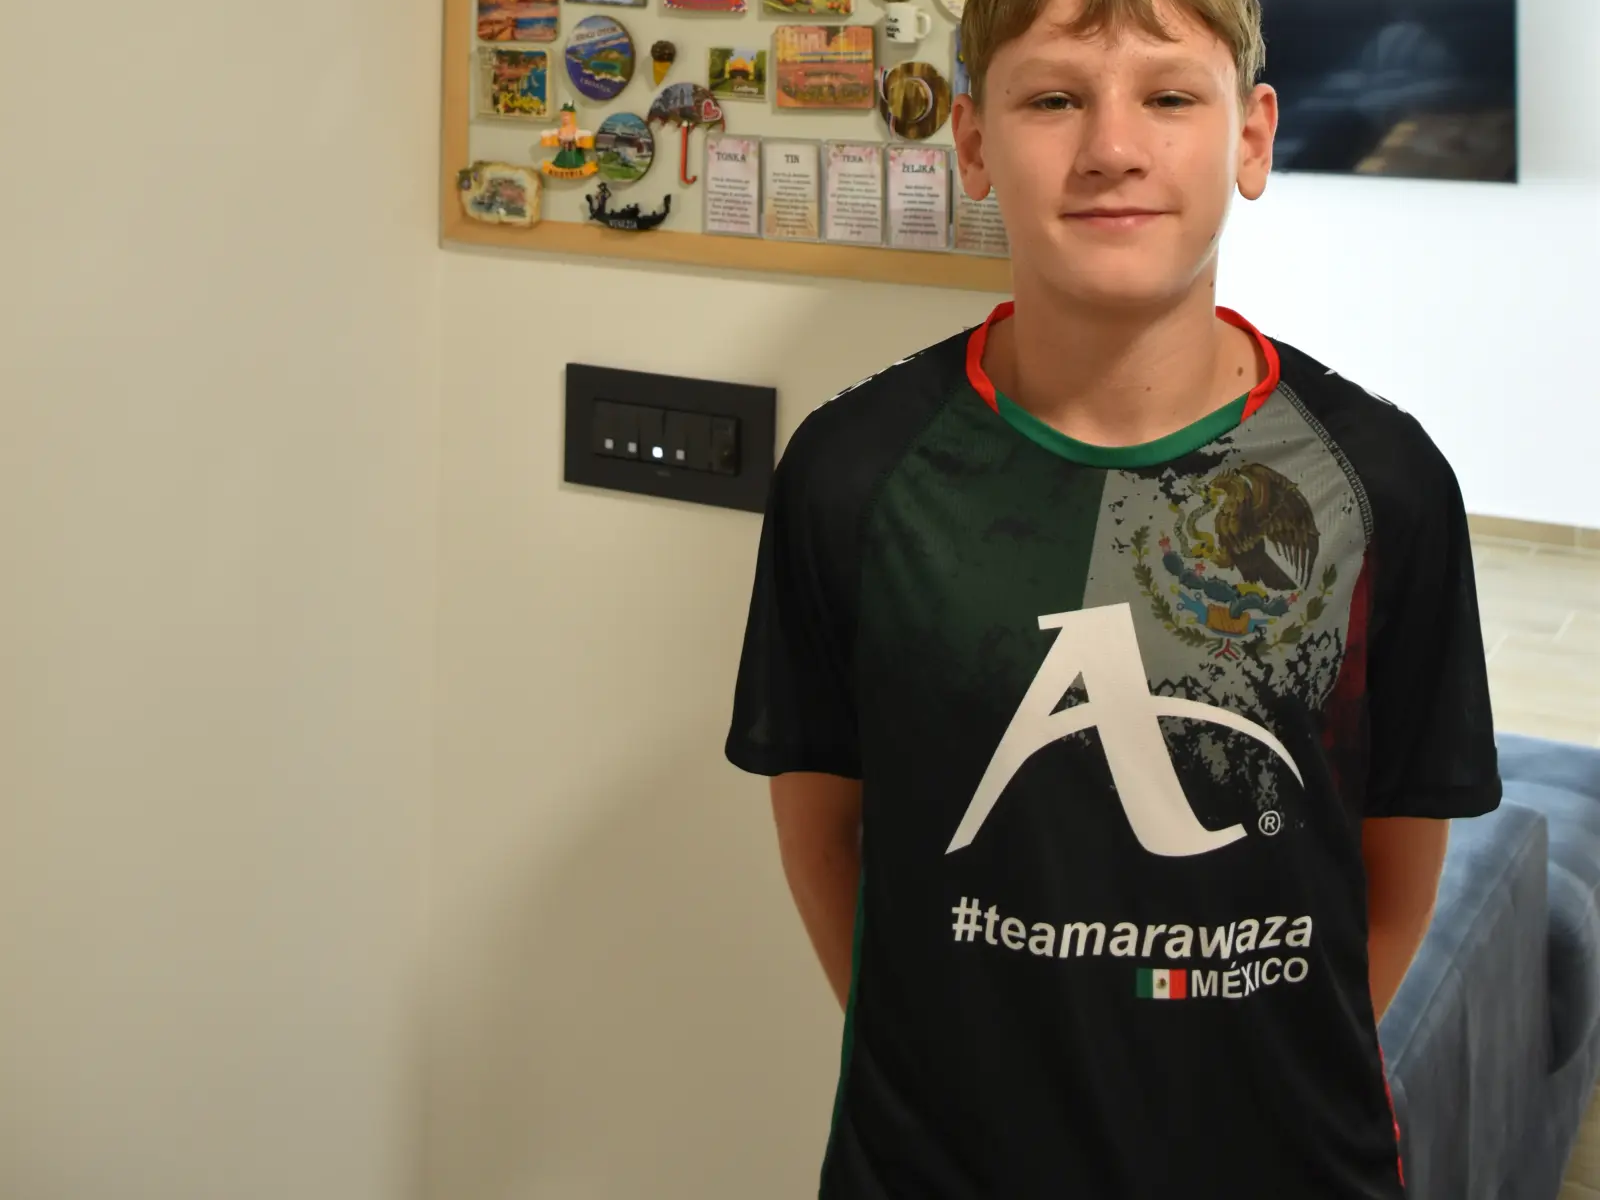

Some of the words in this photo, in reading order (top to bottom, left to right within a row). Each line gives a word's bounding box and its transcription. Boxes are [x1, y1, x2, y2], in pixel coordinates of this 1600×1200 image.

[716, 151, 747, 164] TONKA
[784, 153, 800, 165] TIN
[951, 895, 1314, 962] #teamarawaza
[1190, 956, 1310, 999] MÉXICO
